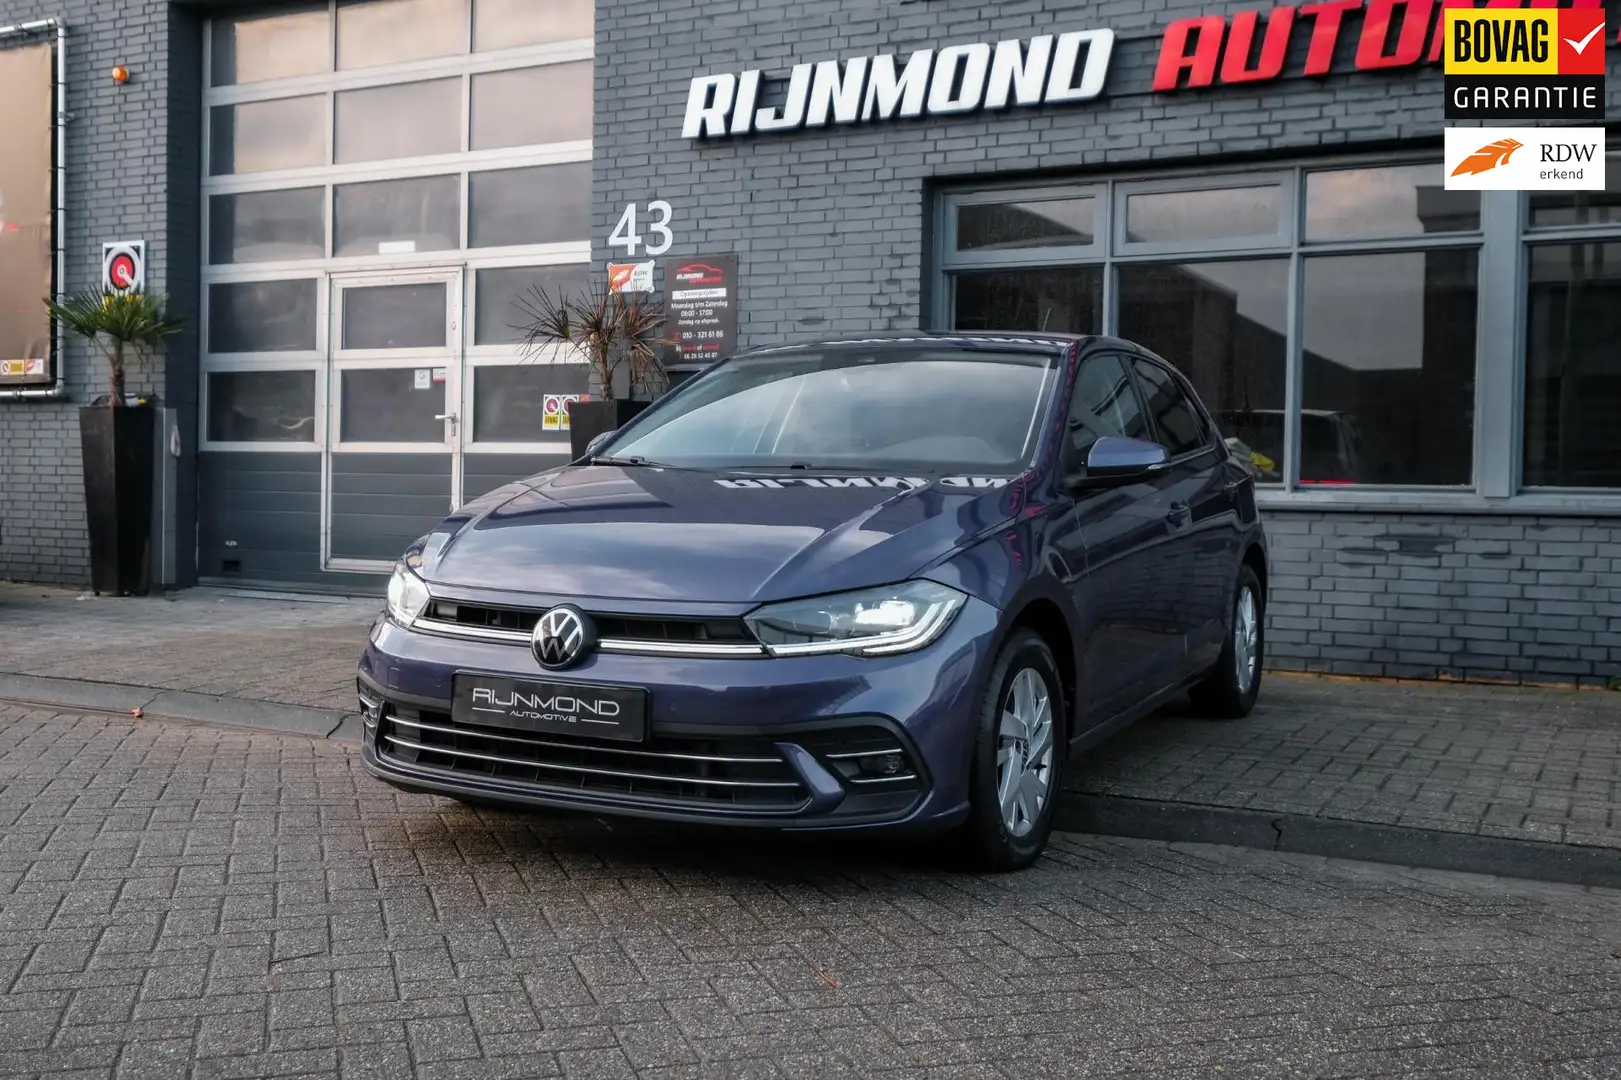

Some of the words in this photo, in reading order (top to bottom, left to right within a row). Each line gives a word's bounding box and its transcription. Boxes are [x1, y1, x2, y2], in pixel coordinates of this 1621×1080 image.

[681, 28, 1115, 138] RIJNMOND
[608, 200, 674, 256] 43
[473, 687, 620, 717] RIJNMOND
[509, 710, 577, 723] AUTOMOTIVE
